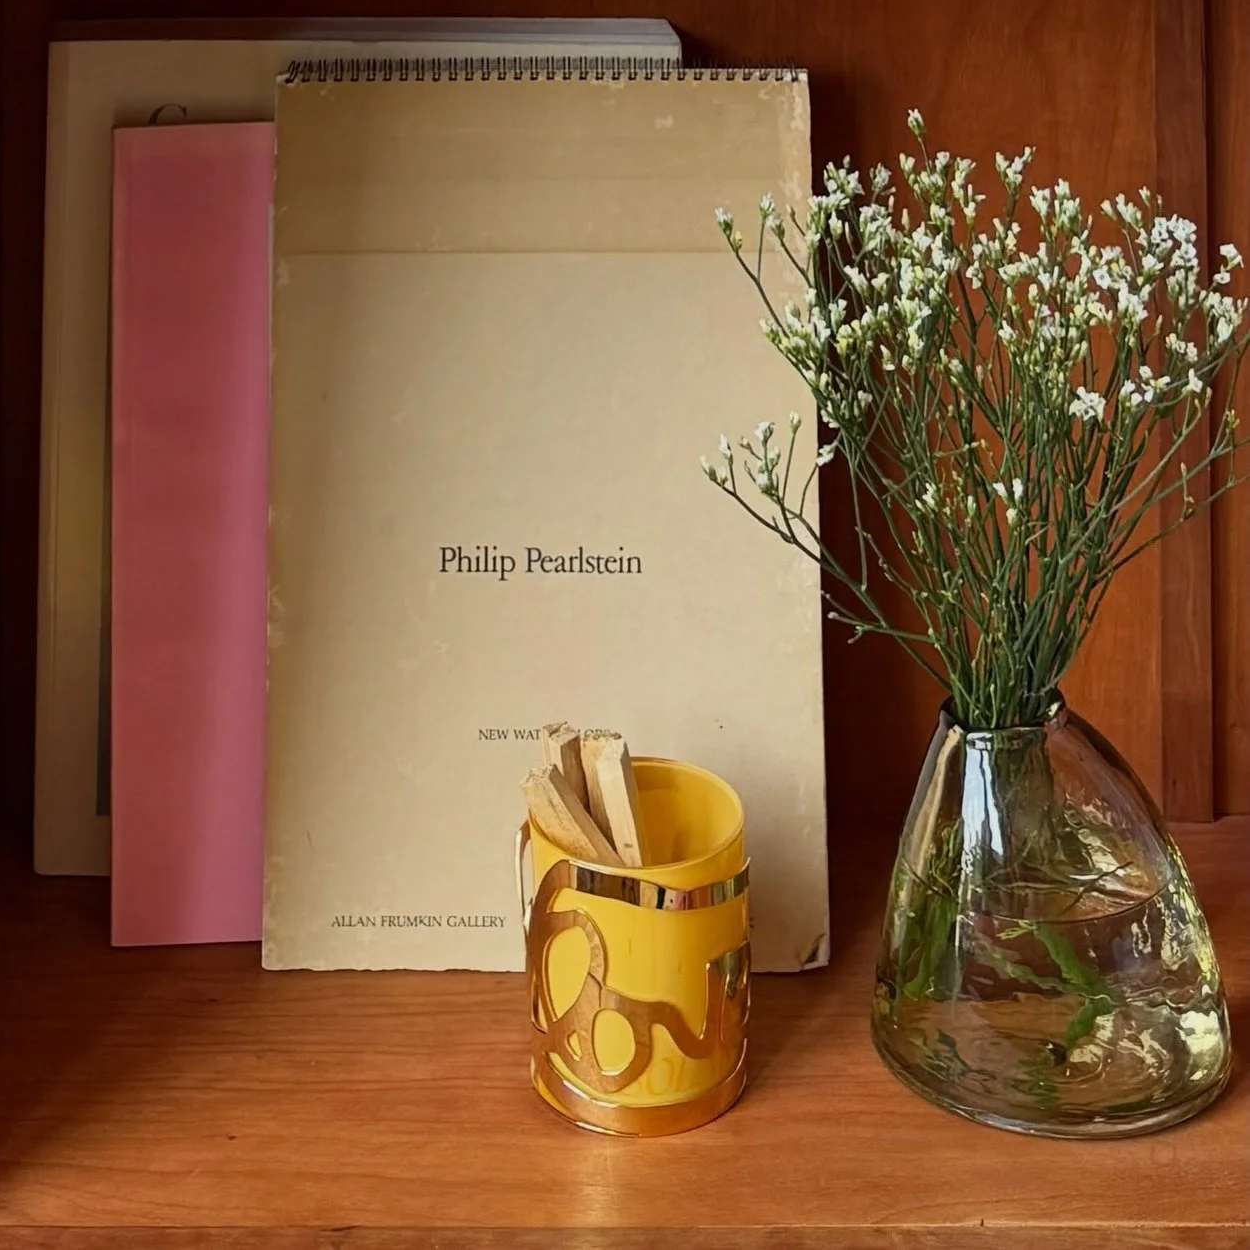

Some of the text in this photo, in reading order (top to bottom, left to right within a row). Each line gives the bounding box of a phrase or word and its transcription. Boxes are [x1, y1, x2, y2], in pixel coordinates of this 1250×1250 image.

[438, 545, 643, 581] Philip Pearlstein
[478, 728, 509, 741] NEW
[331, 915, 506, 928] ALLAN FRUMKIN GALLERY
